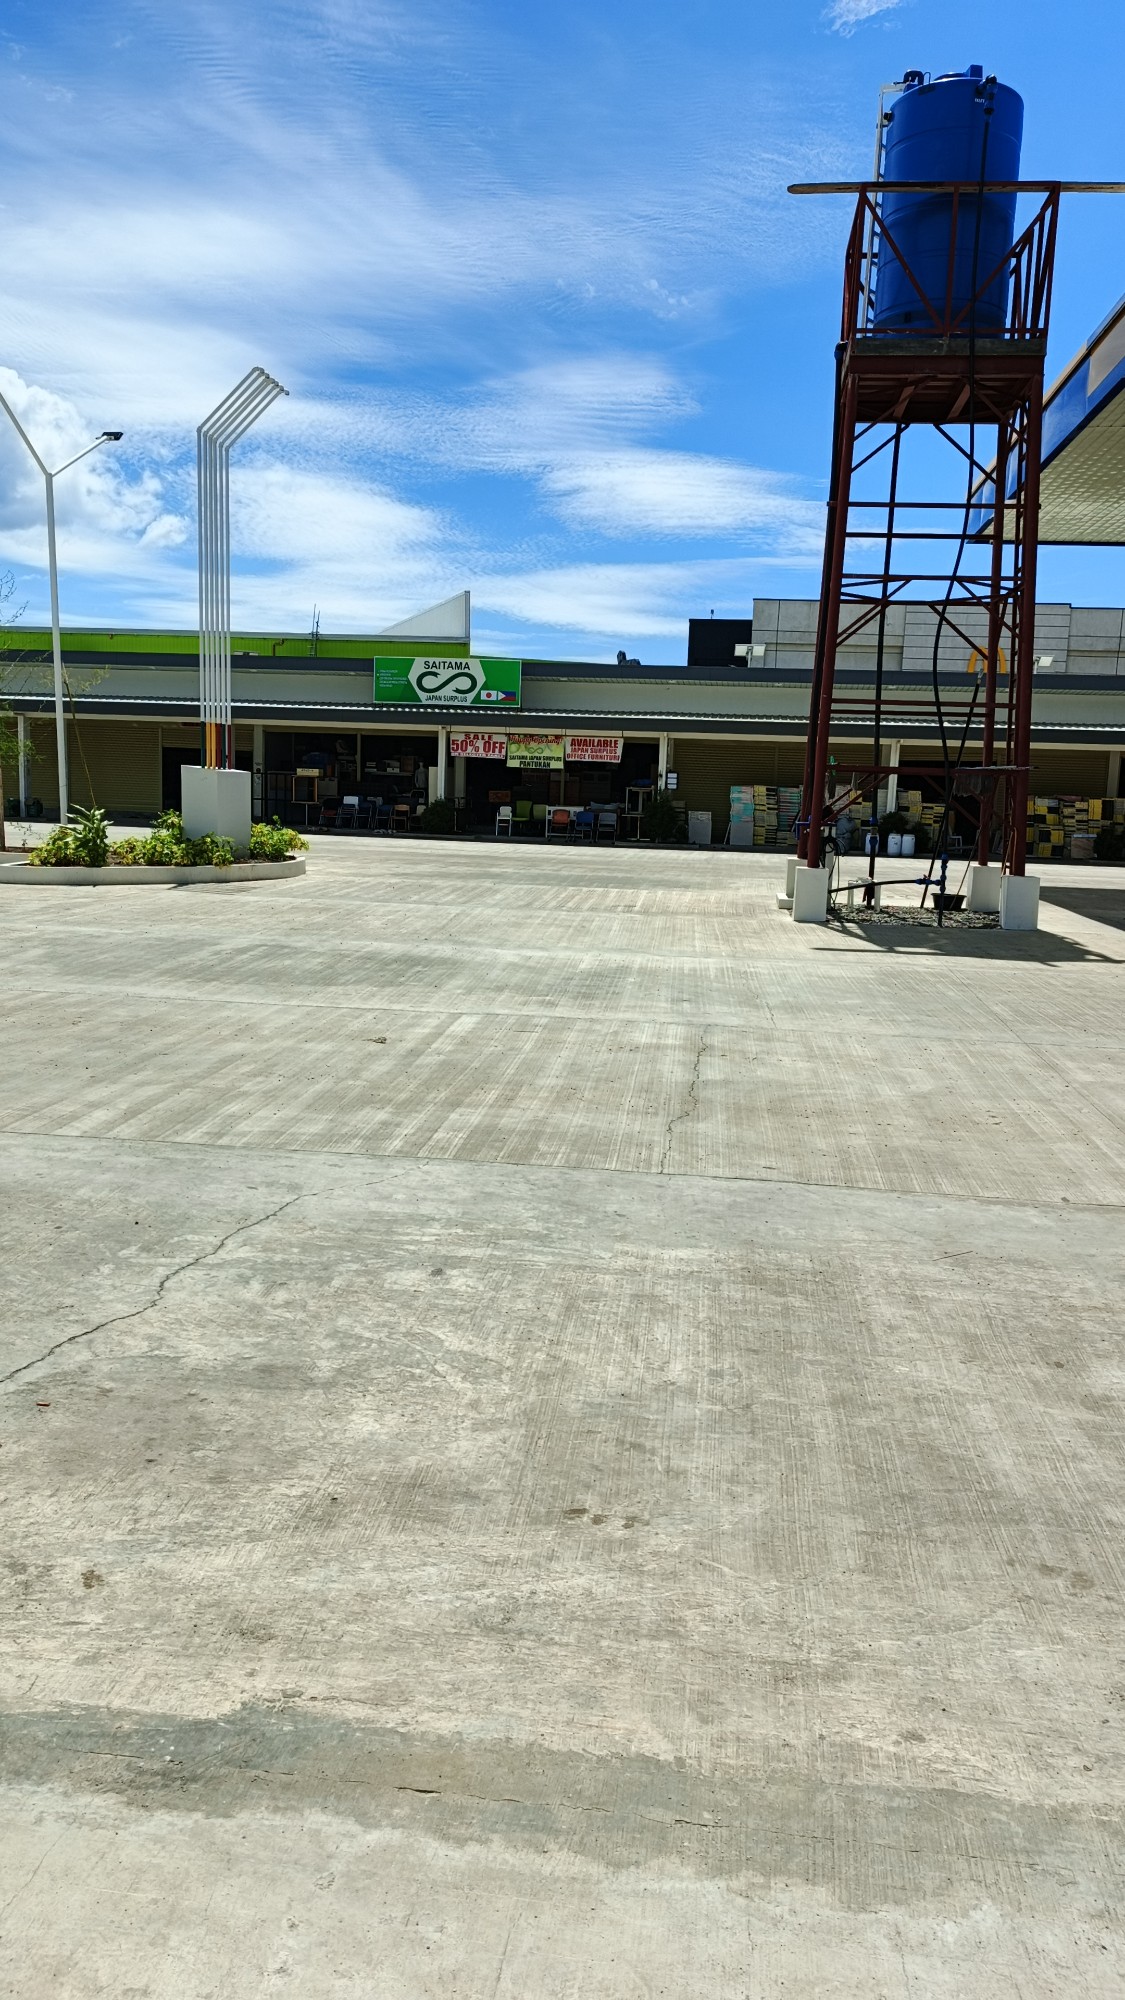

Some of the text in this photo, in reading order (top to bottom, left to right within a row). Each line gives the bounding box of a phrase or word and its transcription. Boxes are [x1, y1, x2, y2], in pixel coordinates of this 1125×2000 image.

[423, 660, 471, 671] SAITAMA
[425, 694, 468, 703] JAPAN SURPLUS
[464, 733, 494, 741] SALE
[451, 739, 506, 754] 50% OFF
[570, 738, 619, 749] AVAILABLE
[519, 760, 551, 769] PANTUKAN
